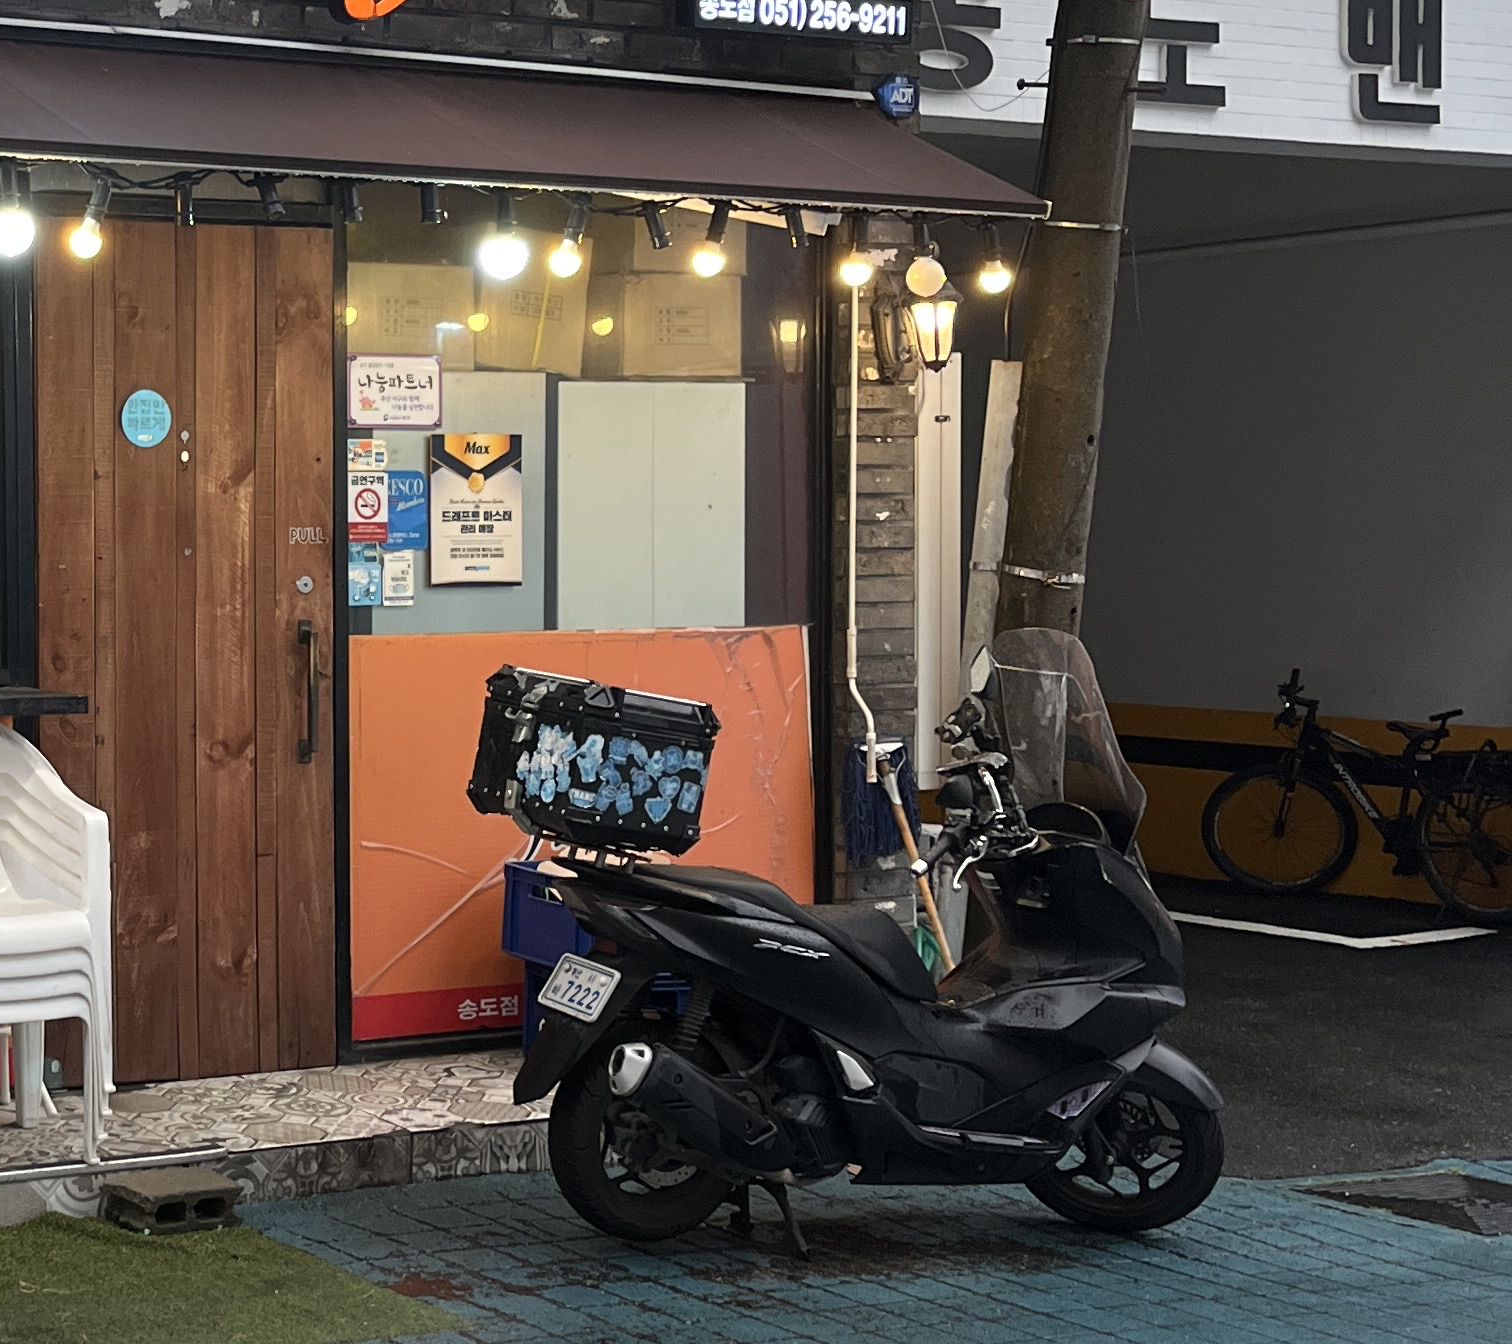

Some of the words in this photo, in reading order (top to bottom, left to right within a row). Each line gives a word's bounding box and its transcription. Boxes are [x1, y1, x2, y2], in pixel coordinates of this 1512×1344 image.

[890, 88, 915, 104] ADT
[464, 441, 491, 455] Max
[388, 478, 424, 496] ESCO
[289, 527, 326, 544] PULL
[561, 980, 600, 1010] 7222
[457, 995, 518, 1021] 송도점
